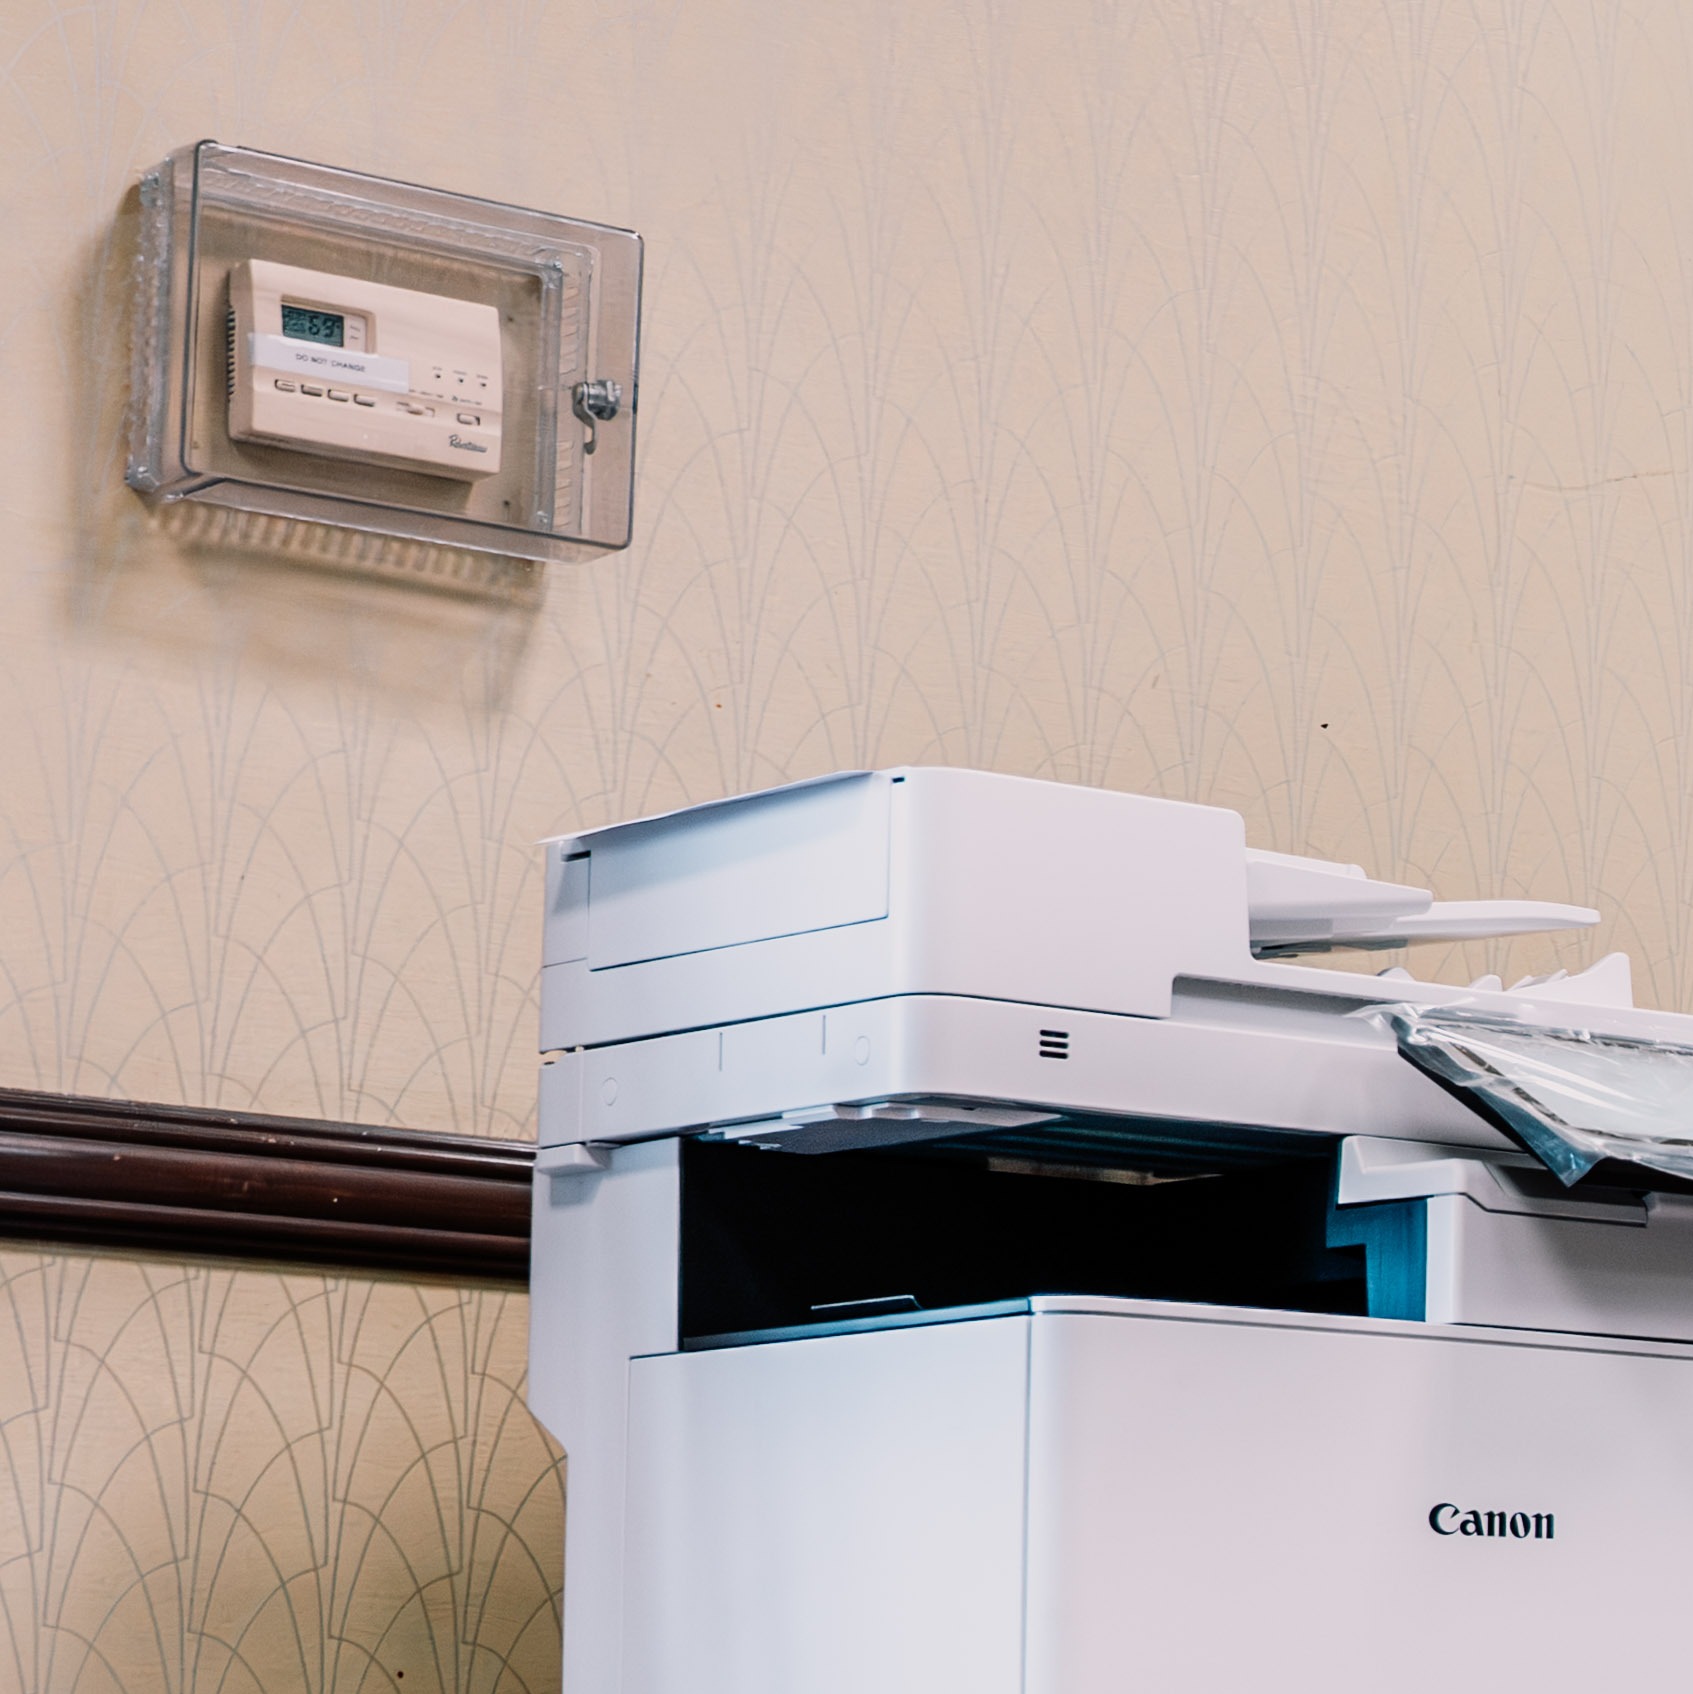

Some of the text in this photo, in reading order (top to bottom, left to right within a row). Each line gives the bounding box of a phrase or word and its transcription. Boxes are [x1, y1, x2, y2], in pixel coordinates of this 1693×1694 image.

[296, 353, 366, 373] DO NOT CHANGE
[1428, 1502, 1554, 1539] Canon
